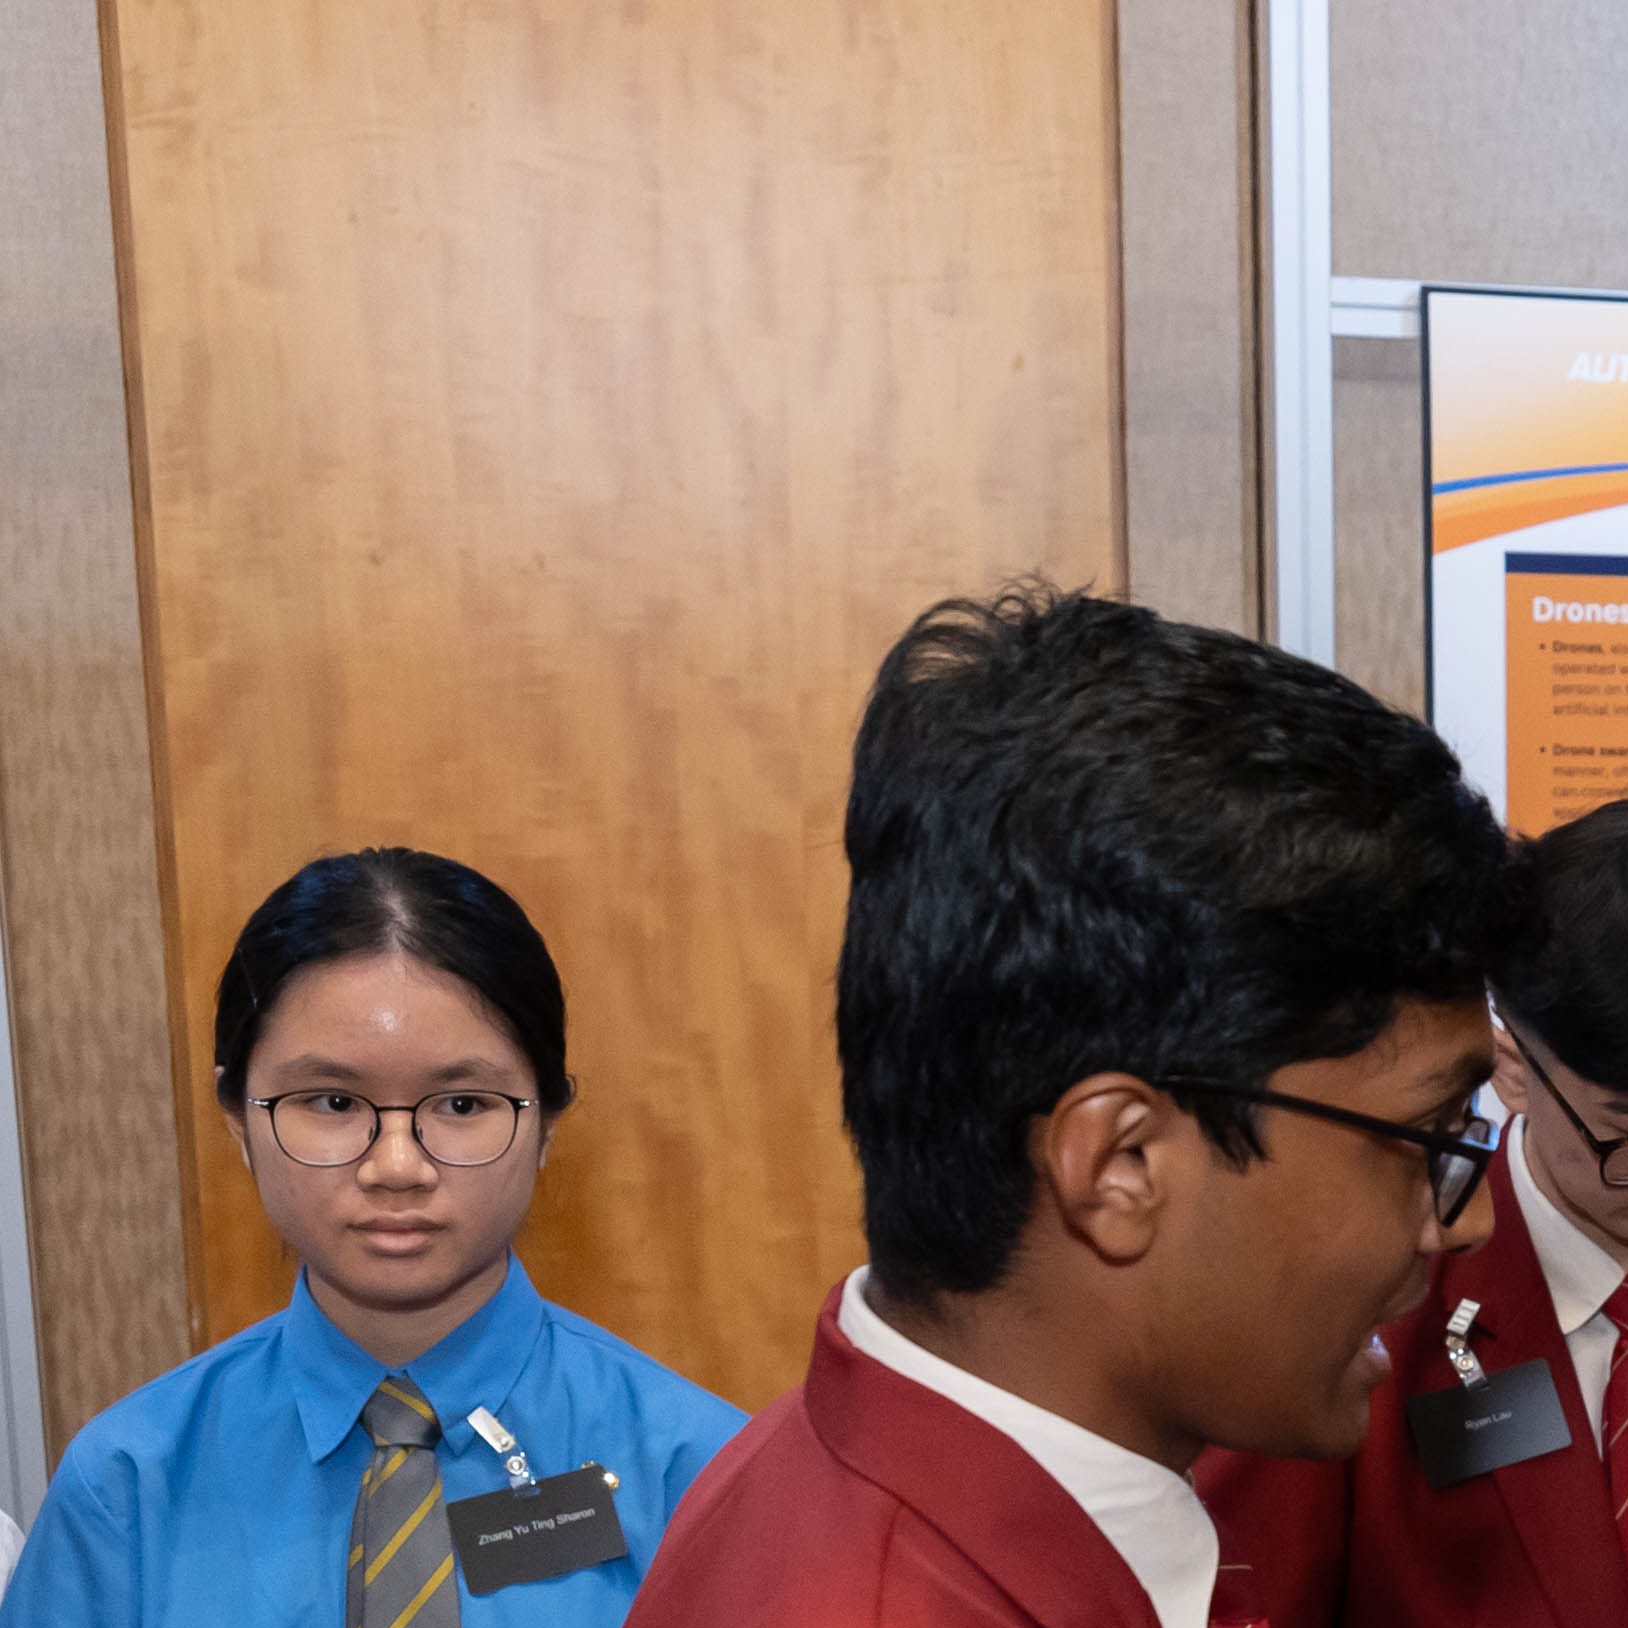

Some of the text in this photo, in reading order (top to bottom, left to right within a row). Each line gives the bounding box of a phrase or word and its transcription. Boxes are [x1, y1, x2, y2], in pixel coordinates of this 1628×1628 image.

[478, 1507, 596, 1546] Zhang Yu Ting Sharon
